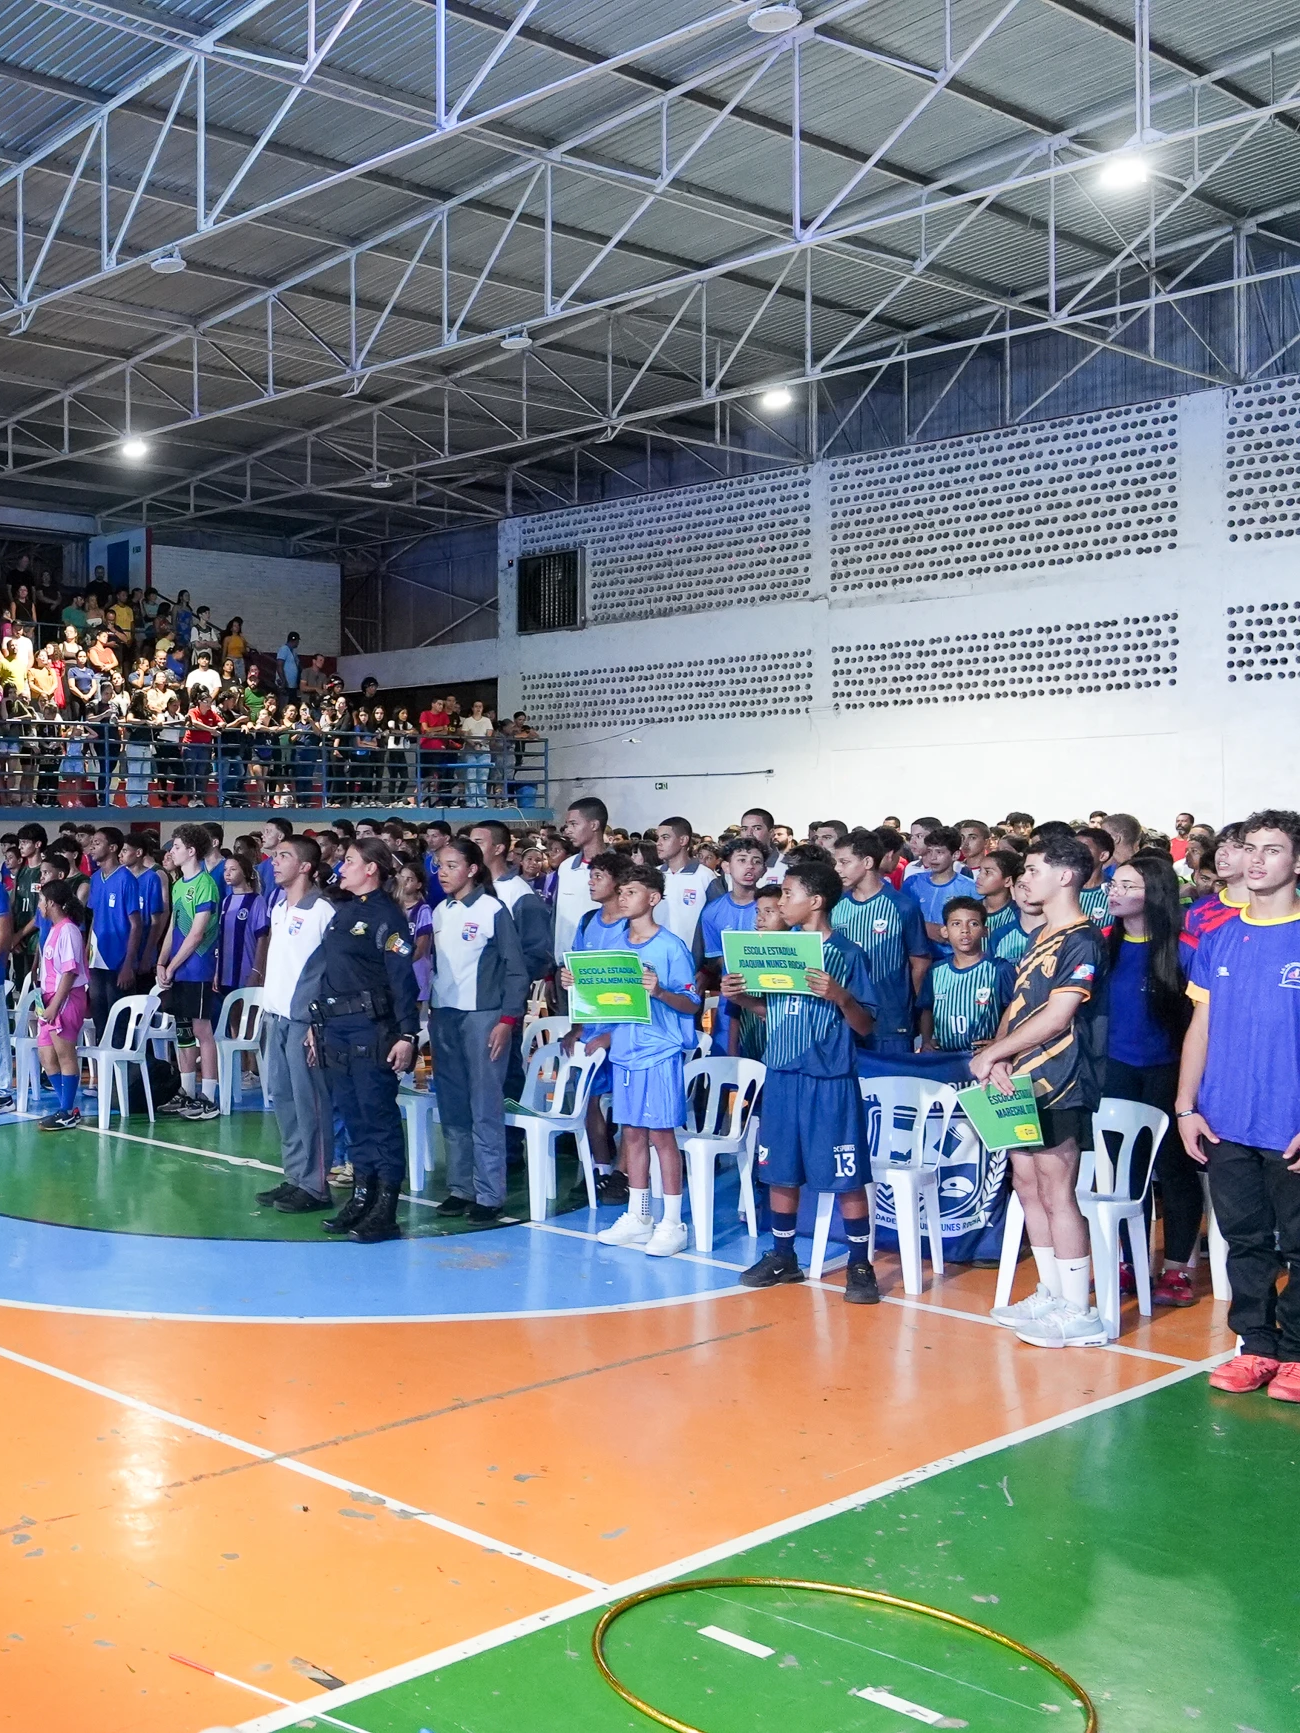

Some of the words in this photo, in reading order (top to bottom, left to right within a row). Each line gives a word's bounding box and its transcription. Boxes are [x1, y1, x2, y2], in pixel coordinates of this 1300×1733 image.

[743, 946, 767, 956] ESCOLA
[767, 946, 798, 956] ESTADUAL
[739, 959, 766, 969] JOAQUIM
[766, 960, 788, 969] NUNES
[788, 960, 807, 970] ROCHA
[578, 967, 606, 975] ESCOLA
[607, 966, 637, 975] ESTADUAL
[950, 1015, 967, 1035] 10
[834, 1152, 856, 1177] 13
[941, 1222, 960, 1231] UNES
